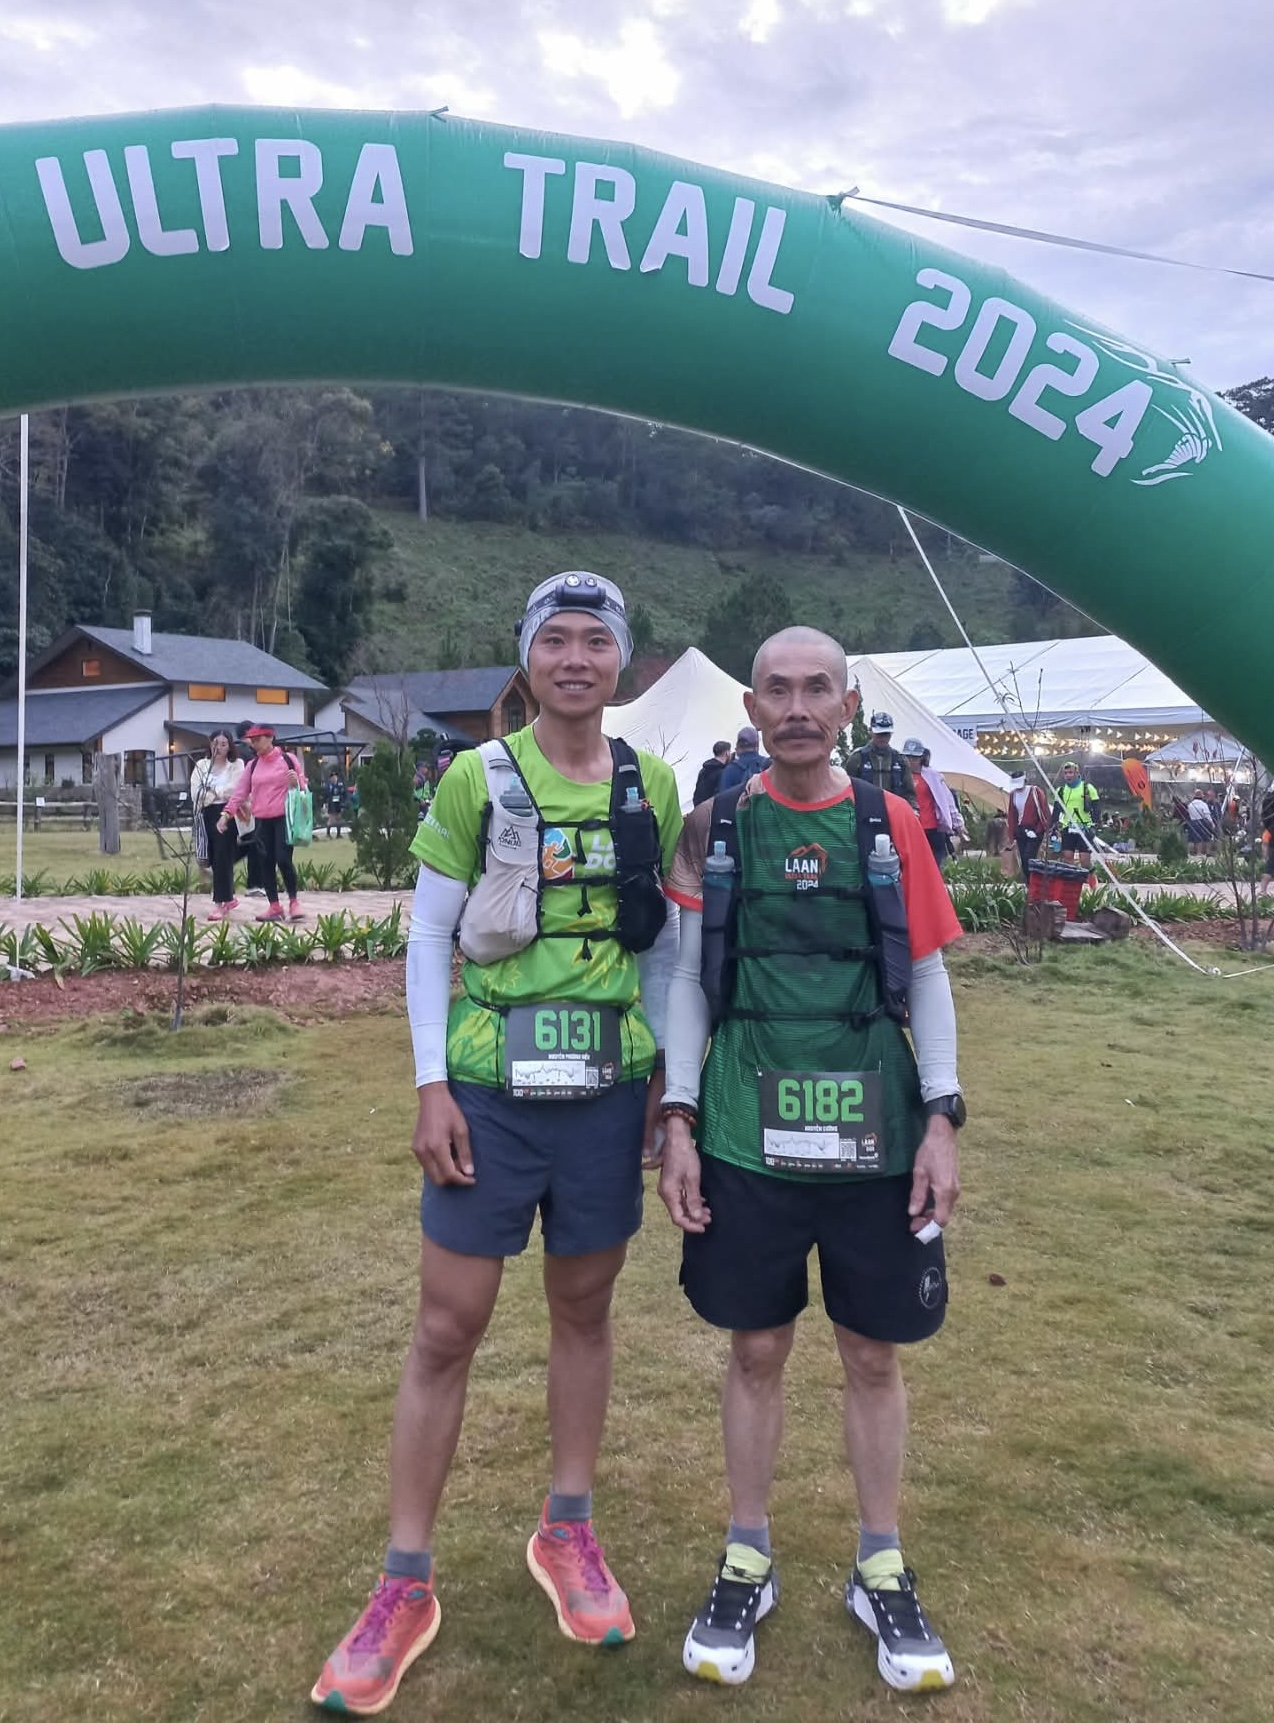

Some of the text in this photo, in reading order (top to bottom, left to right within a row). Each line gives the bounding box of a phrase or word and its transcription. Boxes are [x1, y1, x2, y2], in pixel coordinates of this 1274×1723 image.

[35, 137, 1153, 477] ULTRA TRAIL 2024
[785, 858, 819, 873] LAAN
[535, 1010, 601, 1052] 6131
[778, 1078, 864, 1123] 6182
